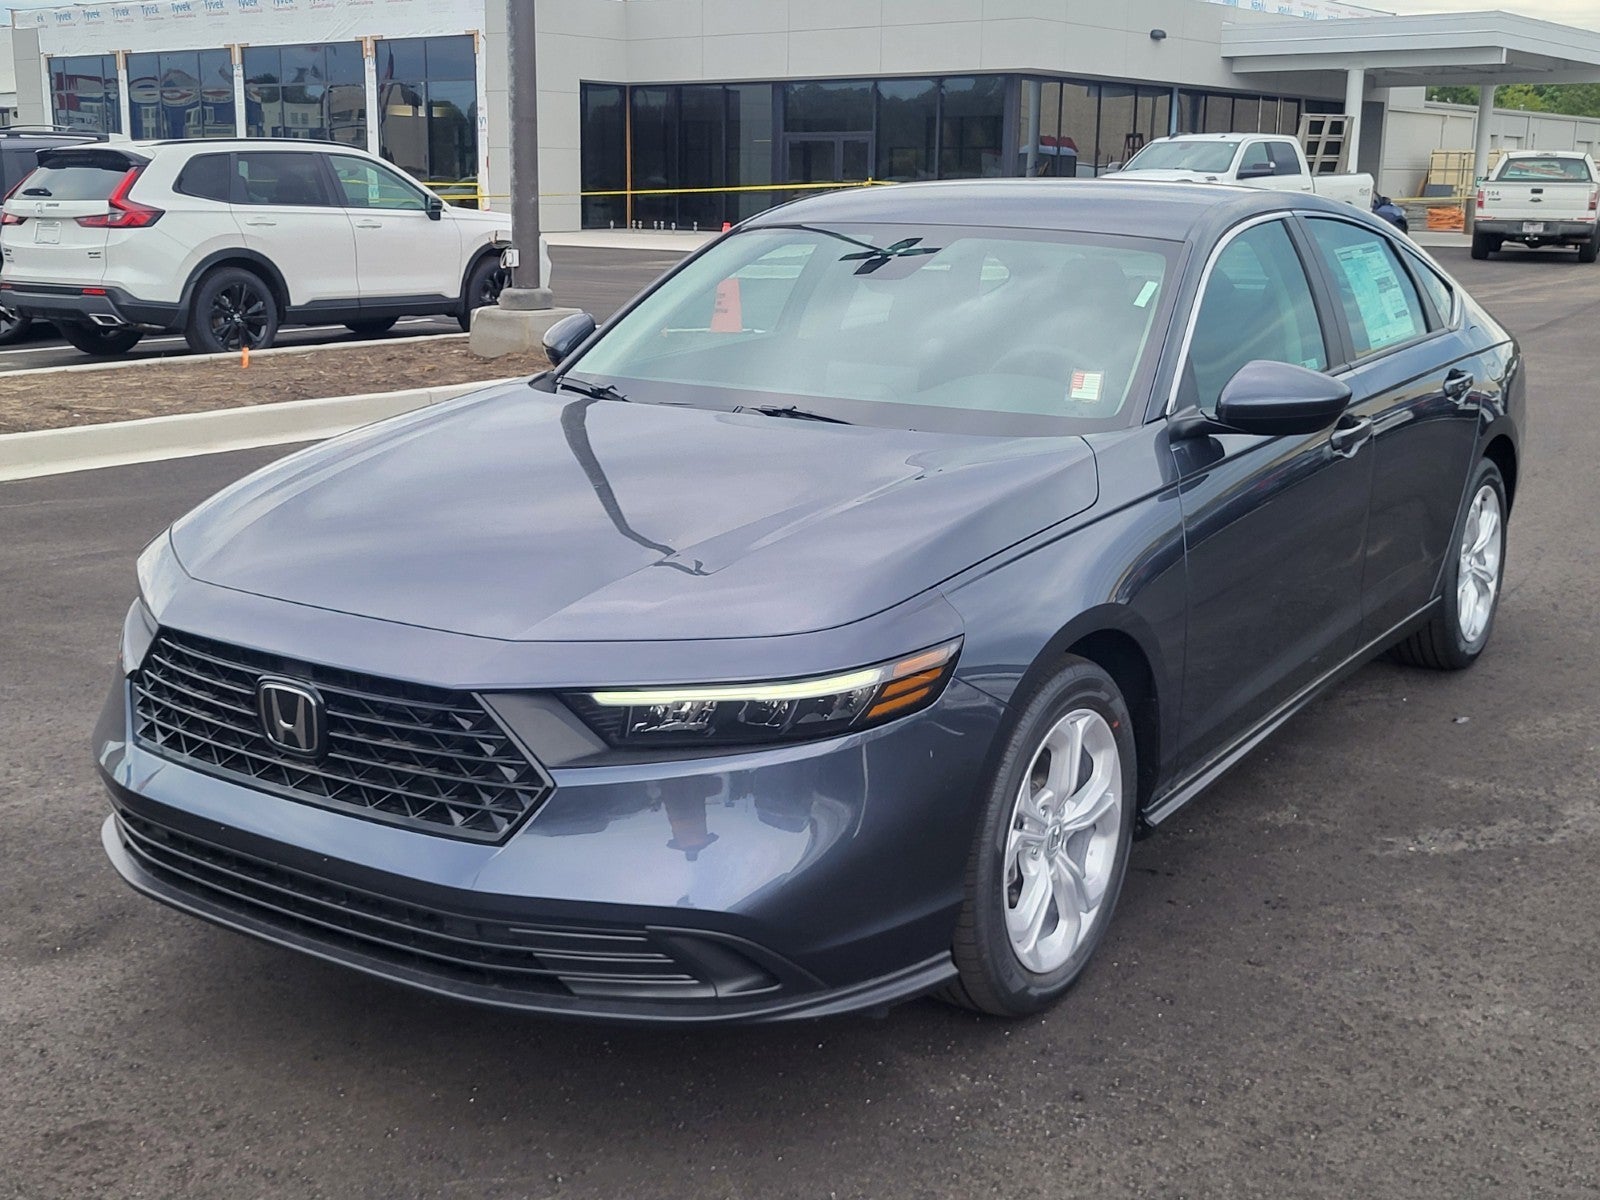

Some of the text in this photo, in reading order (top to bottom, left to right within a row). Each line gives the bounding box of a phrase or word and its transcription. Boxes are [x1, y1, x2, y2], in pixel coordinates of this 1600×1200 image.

[141, 5, 159, 16] Tyvek
[171, 3, 191, 13] Tyvek
[204, 0, 225, 12] Tyvek
[54, 12, 72, 22] Tyvek
[82, 10, 101, 20] Tyvek
[111, 7, 130, 17] Tyvek
